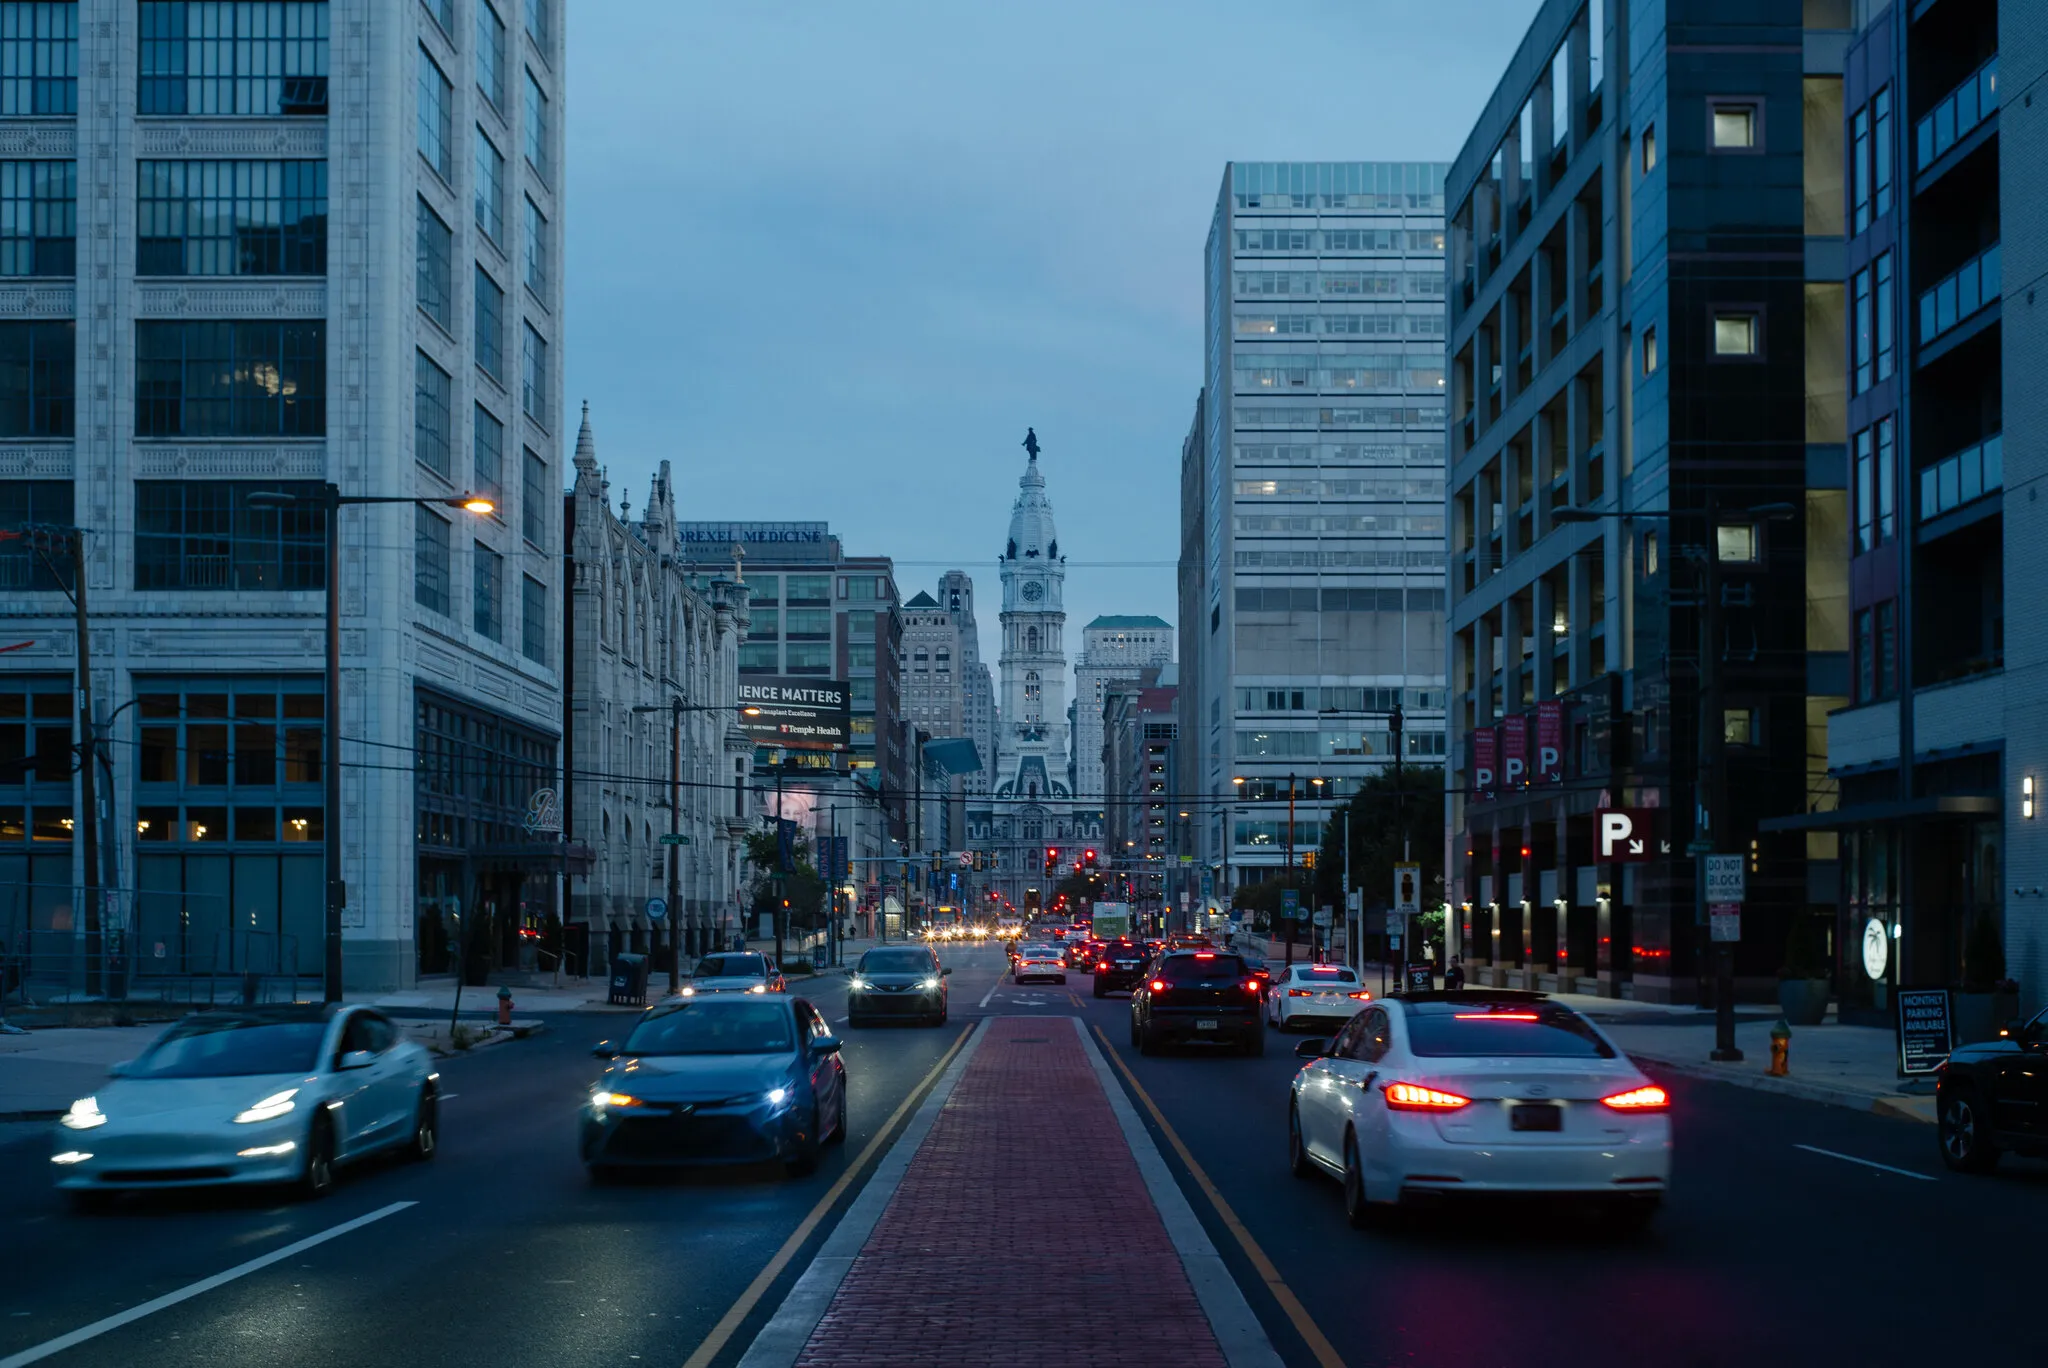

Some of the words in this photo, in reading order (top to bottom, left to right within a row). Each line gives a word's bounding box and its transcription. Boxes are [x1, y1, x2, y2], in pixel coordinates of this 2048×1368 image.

[743, 531, 821, 543] MEDICINE
[782, 688, 842, 704] MATTERS
[759, 708, 787, 717] Transplant
[788, 709, 816, 718] Excellence
[788, 725, 815, 736] Temple
[817, 726, 841, 736] Health
[1540, 746, 1559, 774] P
[1506, 757, 1524, 784] P
[1476, 767, 1493, 791] P
[1602, 812, 1633, 856] P
[820, 839, 829, 878] ROMAN
[1708, 859, 1721, 871] DO
[1724, 859, 1740, 871] NOT
[1709, 874, 1741, 886] BLOCK
[1903, 995, 1943, 1007] MONTHLY
[1905, 1007, 1943, 1019] PARKING
[1905, 1019, 1946, 1031] AVAILABLE
